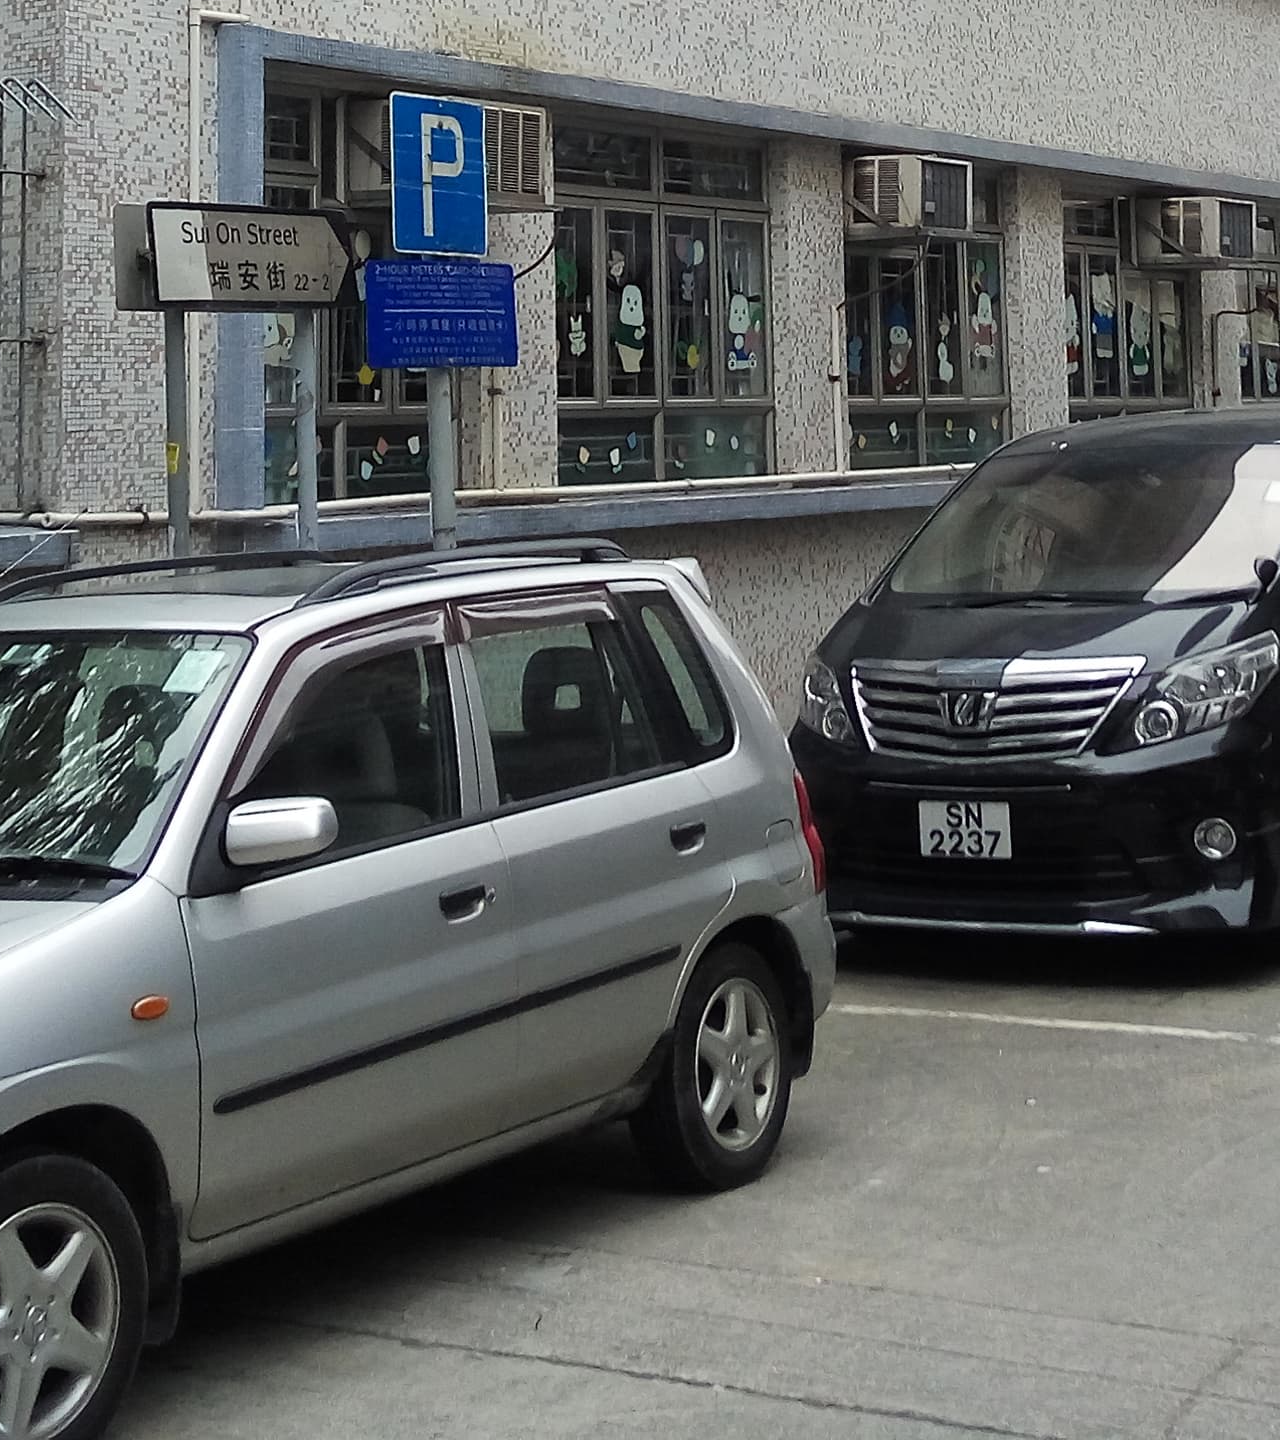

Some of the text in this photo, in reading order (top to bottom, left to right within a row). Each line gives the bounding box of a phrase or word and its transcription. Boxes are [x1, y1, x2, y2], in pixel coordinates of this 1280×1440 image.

[421, 112, 464, 238] P
[181, 220, 300, 247] Sui On Street
[209, 259, 286, 291] 瑞安街
[946, 802, 982, 829] SN
[929, 829, 1001, 857] 2237
